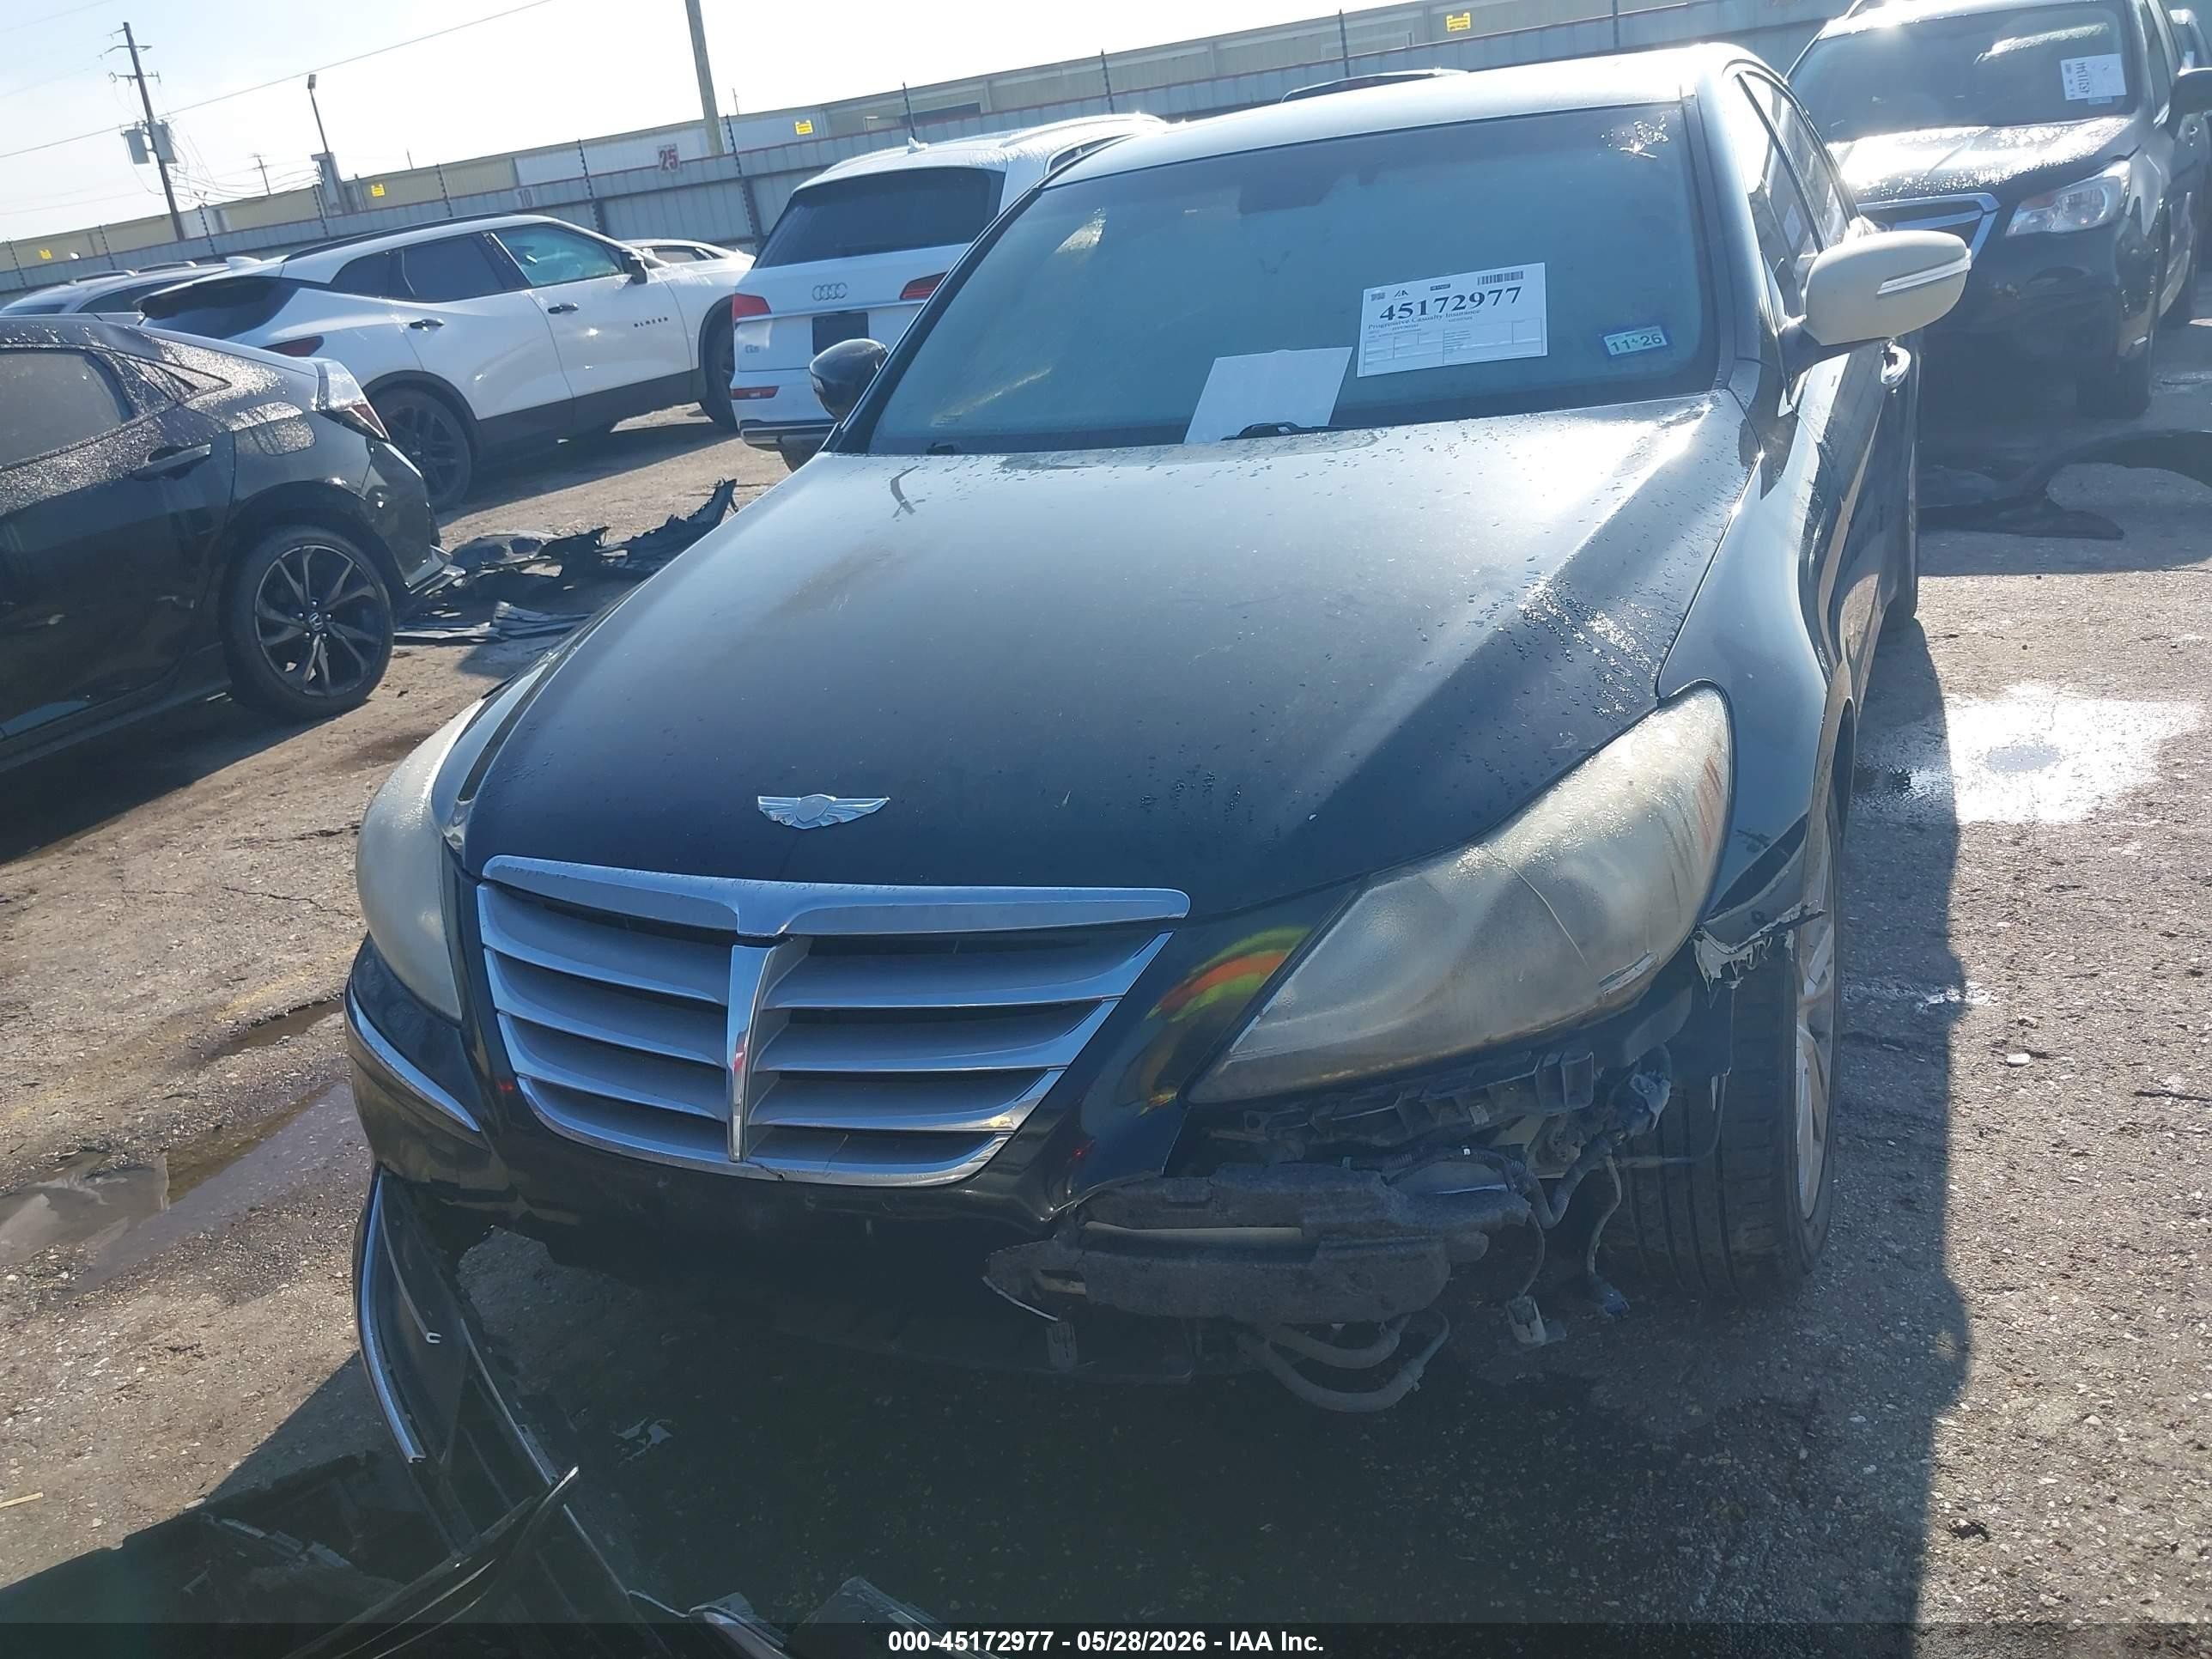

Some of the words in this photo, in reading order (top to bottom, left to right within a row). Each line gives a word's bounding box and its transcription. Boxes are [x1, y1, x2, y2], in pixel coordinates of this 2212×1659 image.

[659, 149, 678, 171] 25
[518, 188, 534, 208] 10
[1379, 285, 1522, 321] 45172977
[1368, 318, 1410, 331] Progressive
[1411, 313, 1443, 324] Casualty
[1445, 308, 1481, 319] Insurance
